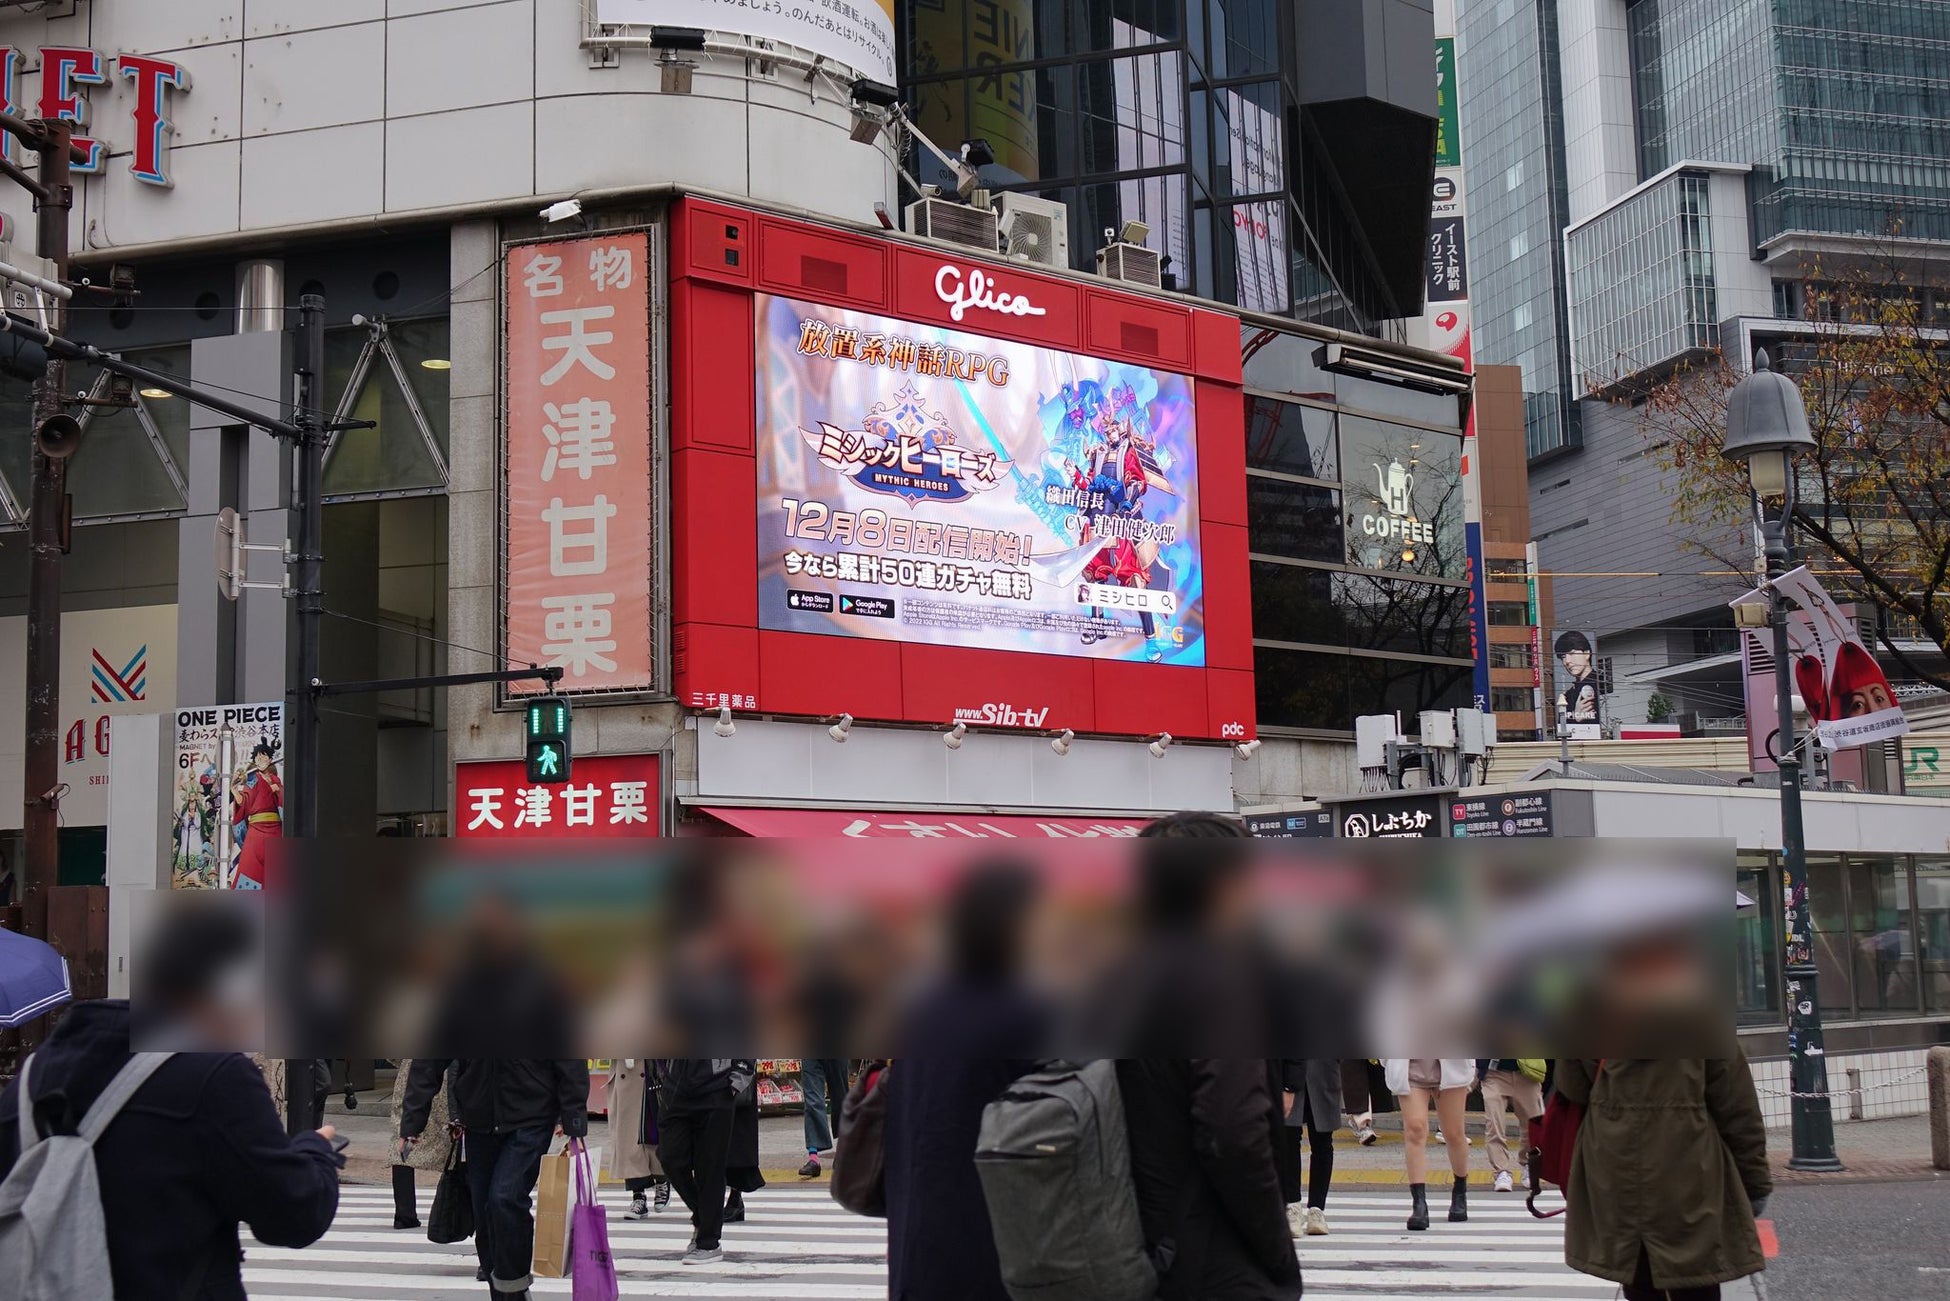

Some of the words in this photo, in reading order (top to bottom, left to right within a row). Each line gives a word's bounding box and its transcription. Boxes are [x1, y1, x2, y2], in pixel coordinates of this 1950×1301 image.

[0, 45, 192, 189] ET
[1431, 233, 1444, 286] クリニック
[1445, 223, 1461, 291] イースト駅前
[523, 246, 632, 298] 名物
[935, 265, 1046, 321] Glico
[799, 319, 1010, 389] 放置系神話RPG
[817, 421, 997, 483] ミシックヒーローズ
[540, 305, 617, 677] 天津甘栗
[874, 473, 910, 487] MYTHIC
[913, 479, 949, 492] HEROES
[1046, 485, 1105, 510] 織田信長
[1095, 514, 1176, 545] 津田健次郎
[1363, 515, 1433, 543] COFFEE
[784, 551, 1033, 600] 今なら累計50連ガチャ無料
[801, 594, 814, 602] App
[815, 595, 830, 603] Store
[855, 599, 875, 609] Google
[876, 601, 888, 610] Play
[1100, 590, 1148, 607] ミシヒロ
[692, 692, 756, 709] 三千里薬品
[178, 710, 217, 727] ONE
[224, 706, 280, 723] PIECE
[1222, 721, 1244, 738] pdc
[1904, 747, 1940, 773] JR
[467, 781, 648, 831] 天津甘栗
[1372, 810, 1432, 832] しぶちか
